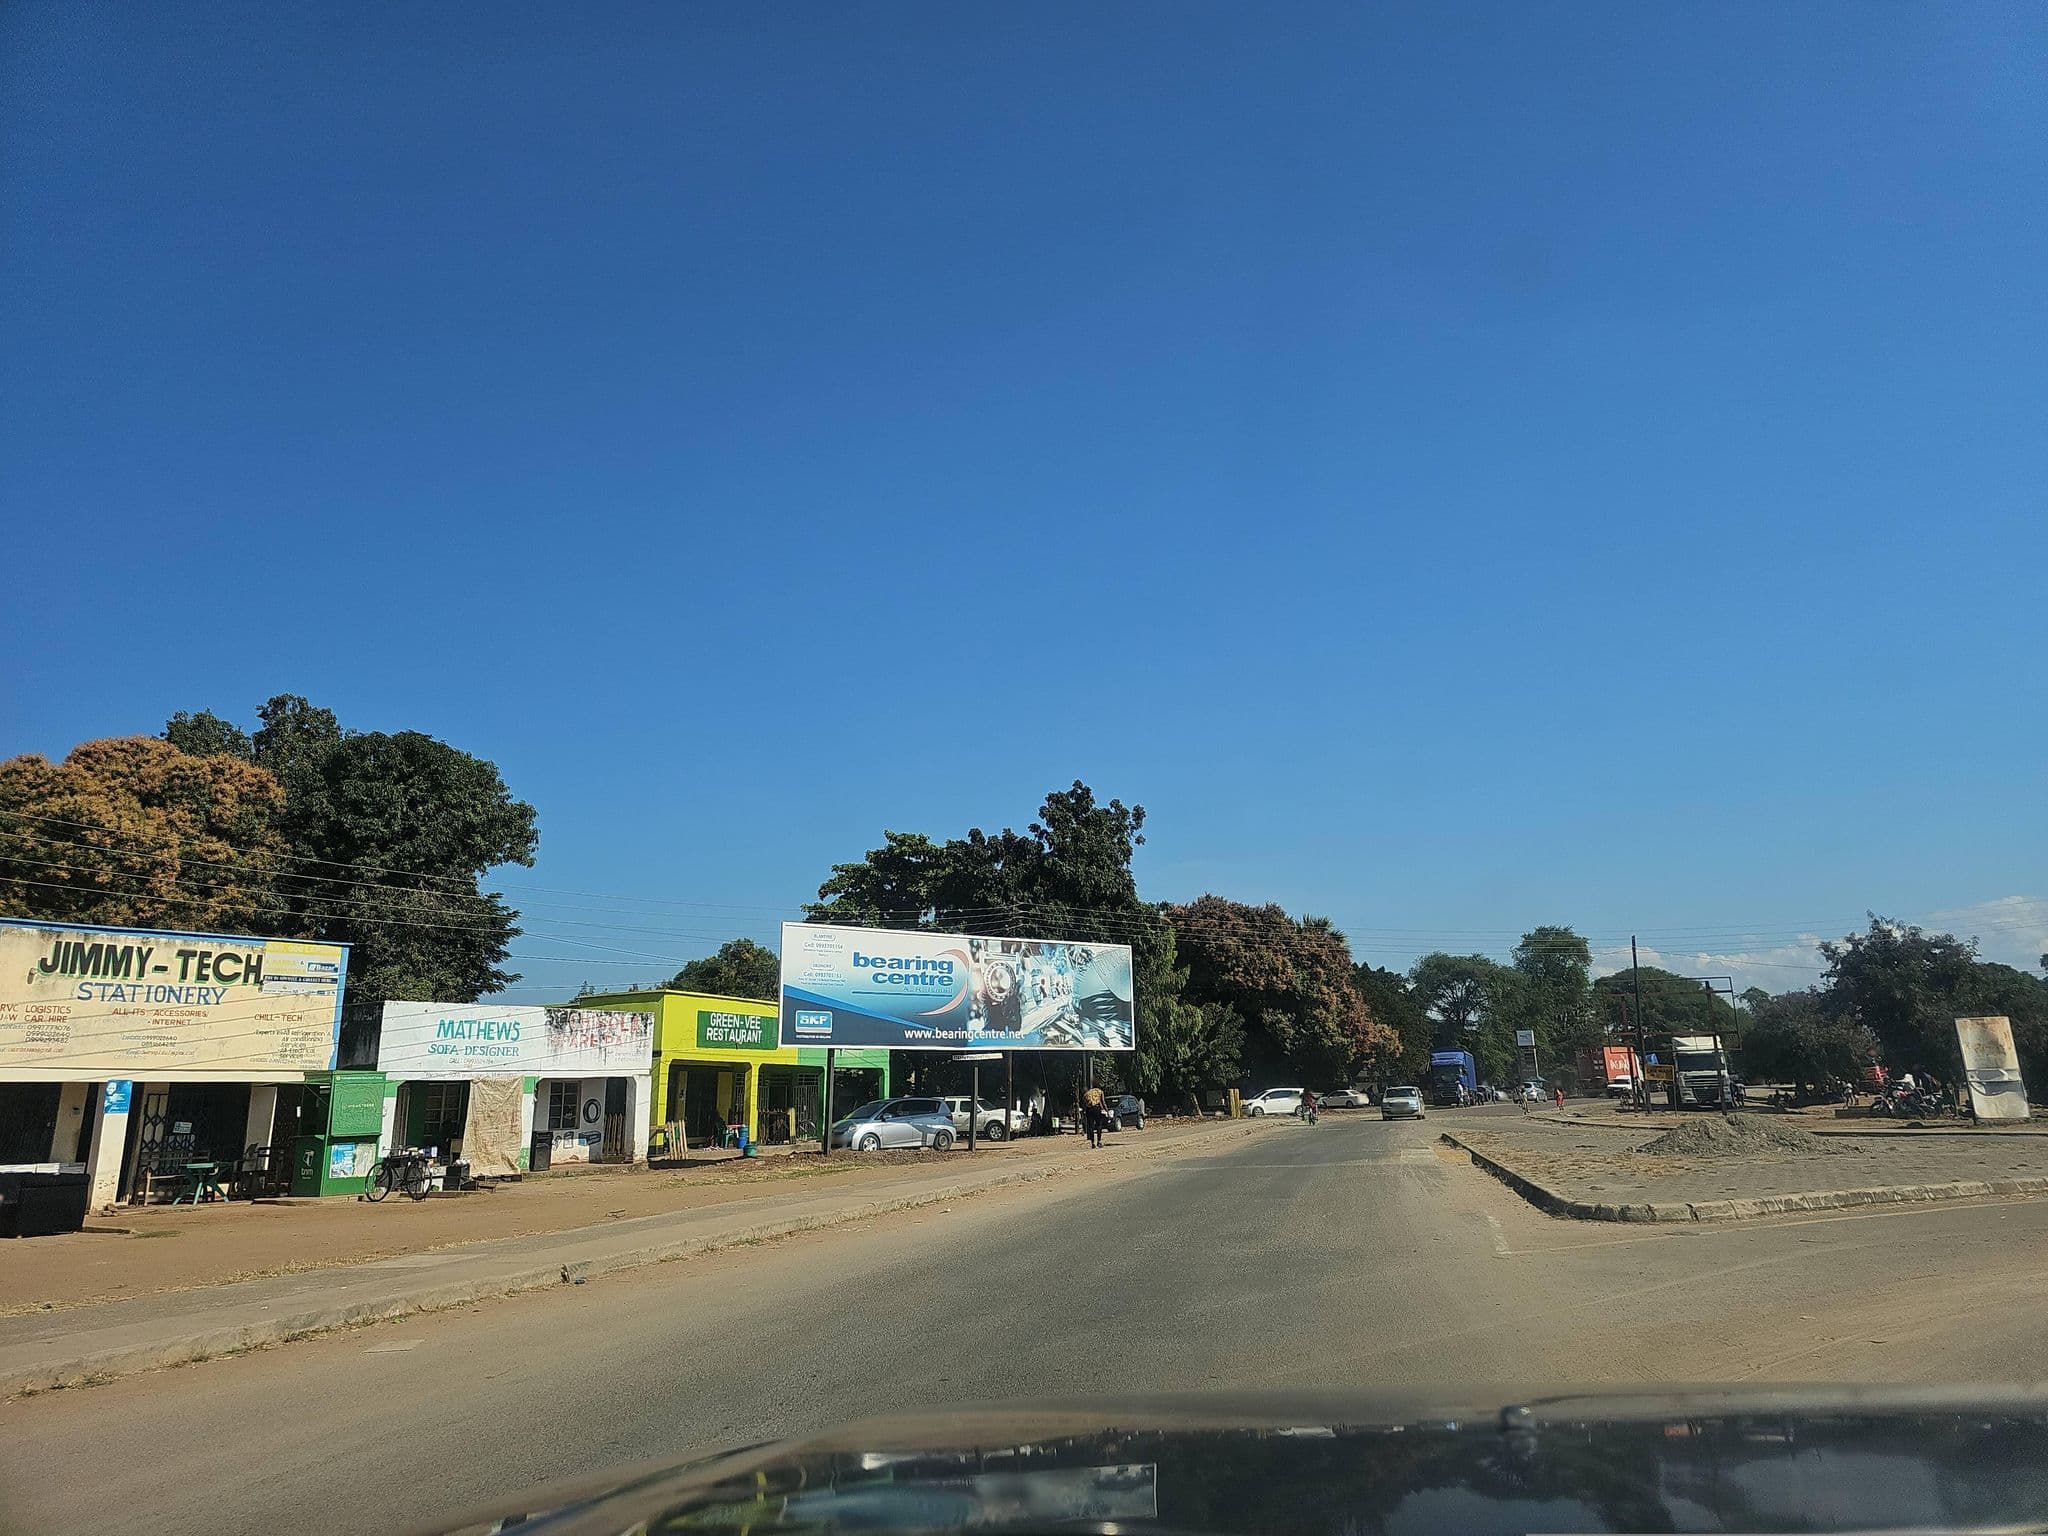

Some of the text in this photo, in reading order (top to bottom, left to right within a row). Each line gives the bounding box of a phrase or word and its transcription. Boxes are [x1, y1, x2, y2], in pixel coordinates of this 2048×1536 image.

[853, 952, 954, 974] bearing
[872, 971, 954, 986] centre
[77, 981, 229, 1006] STATIONERY
[25, 1005, 72, 1014] LOGISTICS
[112, 1008, 129, 1016] ALL
[24, 1014, 47, 1023] CAR
[48, 1015, 69, 1024] HIRE
[152, 1018, 192, 1026] INTERNET
[710, 1013, 762, 1030] GREEN-VEE
[799, 1015, 828, 1025] SKF
[436, 1019, 521, 1042] MATHEWS
[706, 1027, 762, 1044] RESTAURANT
[904, 1026, 1025, 1043] www.bearingcentre.net
[428, 1043, 520, 1057] SOFA DESIGNER
